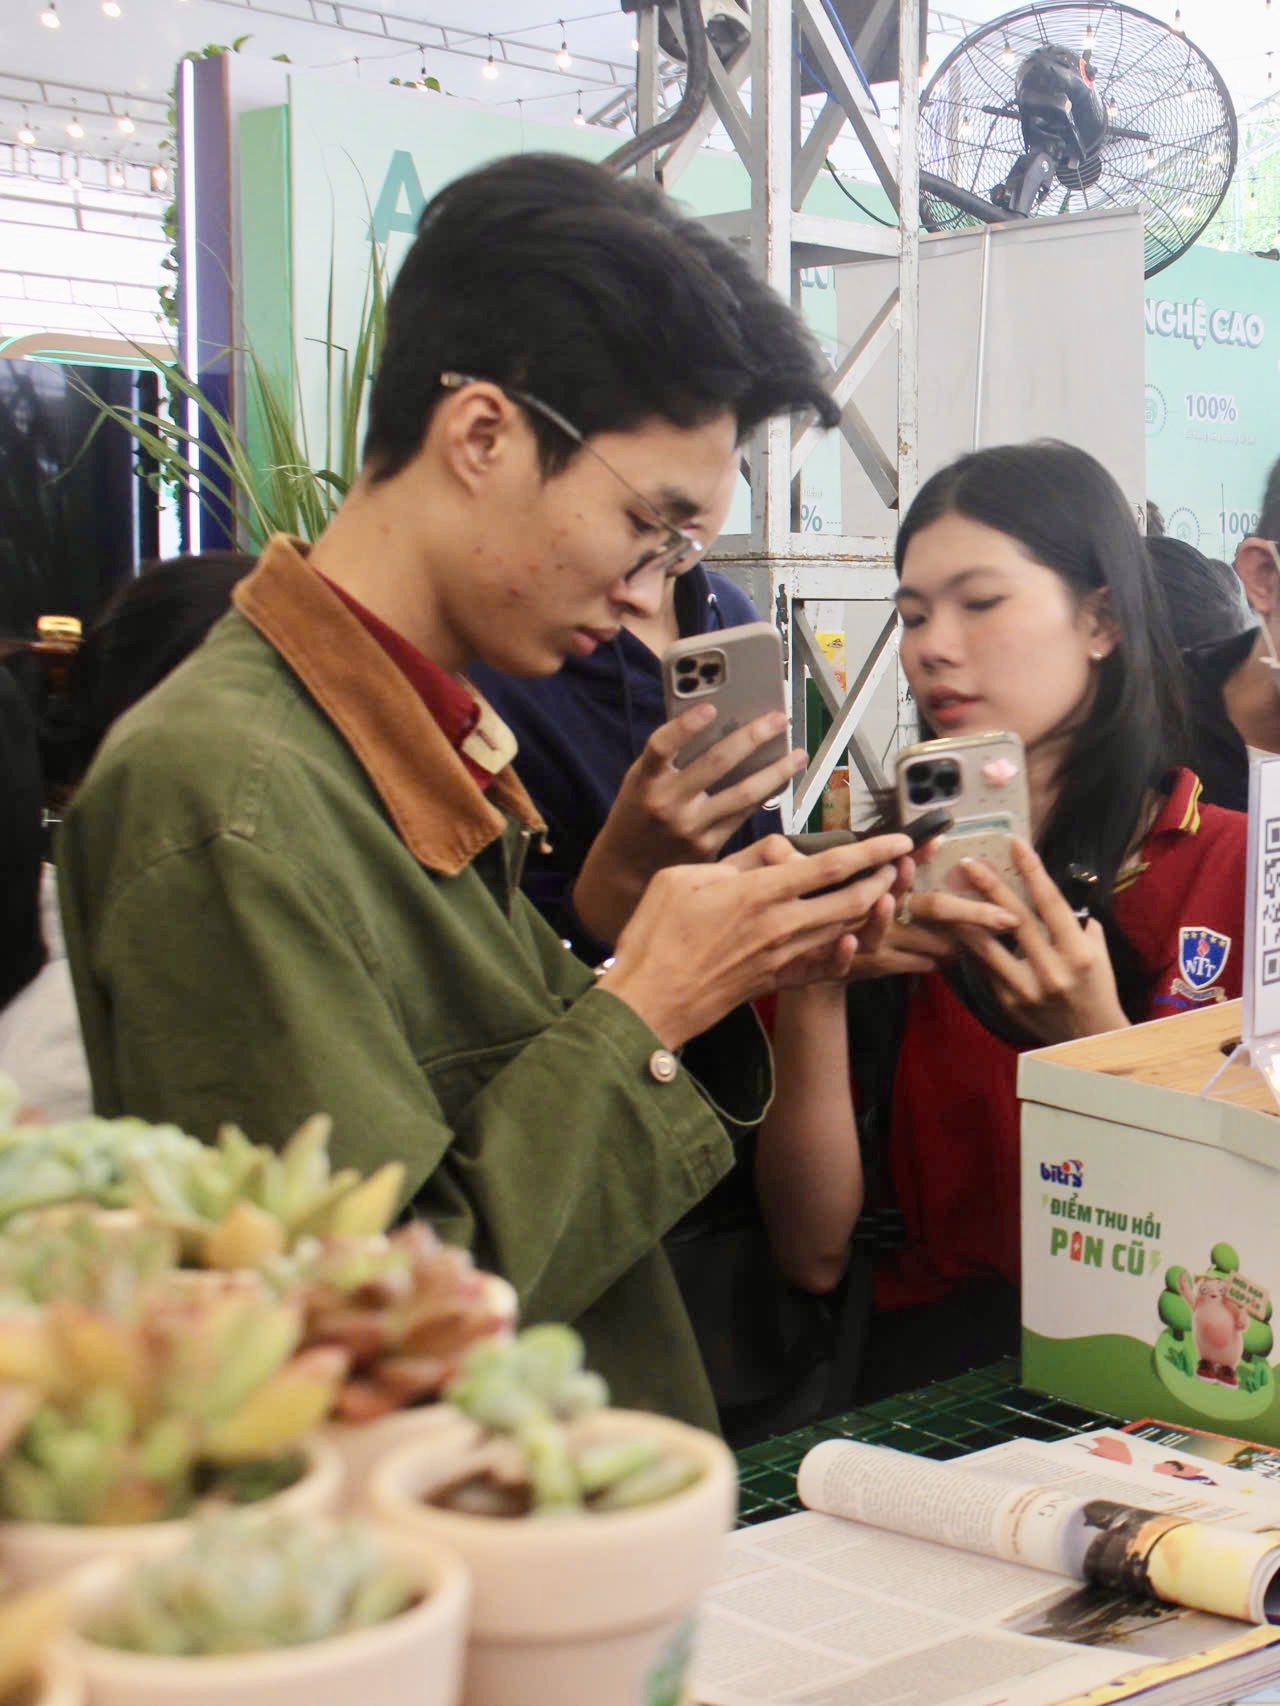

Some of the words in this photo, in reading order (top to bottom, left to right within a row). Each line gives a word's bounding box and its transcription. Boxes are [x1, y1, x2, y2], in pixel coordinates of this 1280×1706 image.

[1210, 308, 1266, 349] CAO
[1185, 393, 1237, 421] 100%
[1050, 1193, 1092, 1223] ĐIỂM
[1096, 1207, 1128, 1231] THU
[1131, 1211, 1161, 1239] HỒI
[1111, 1240, 1145, 1276] CŨ
